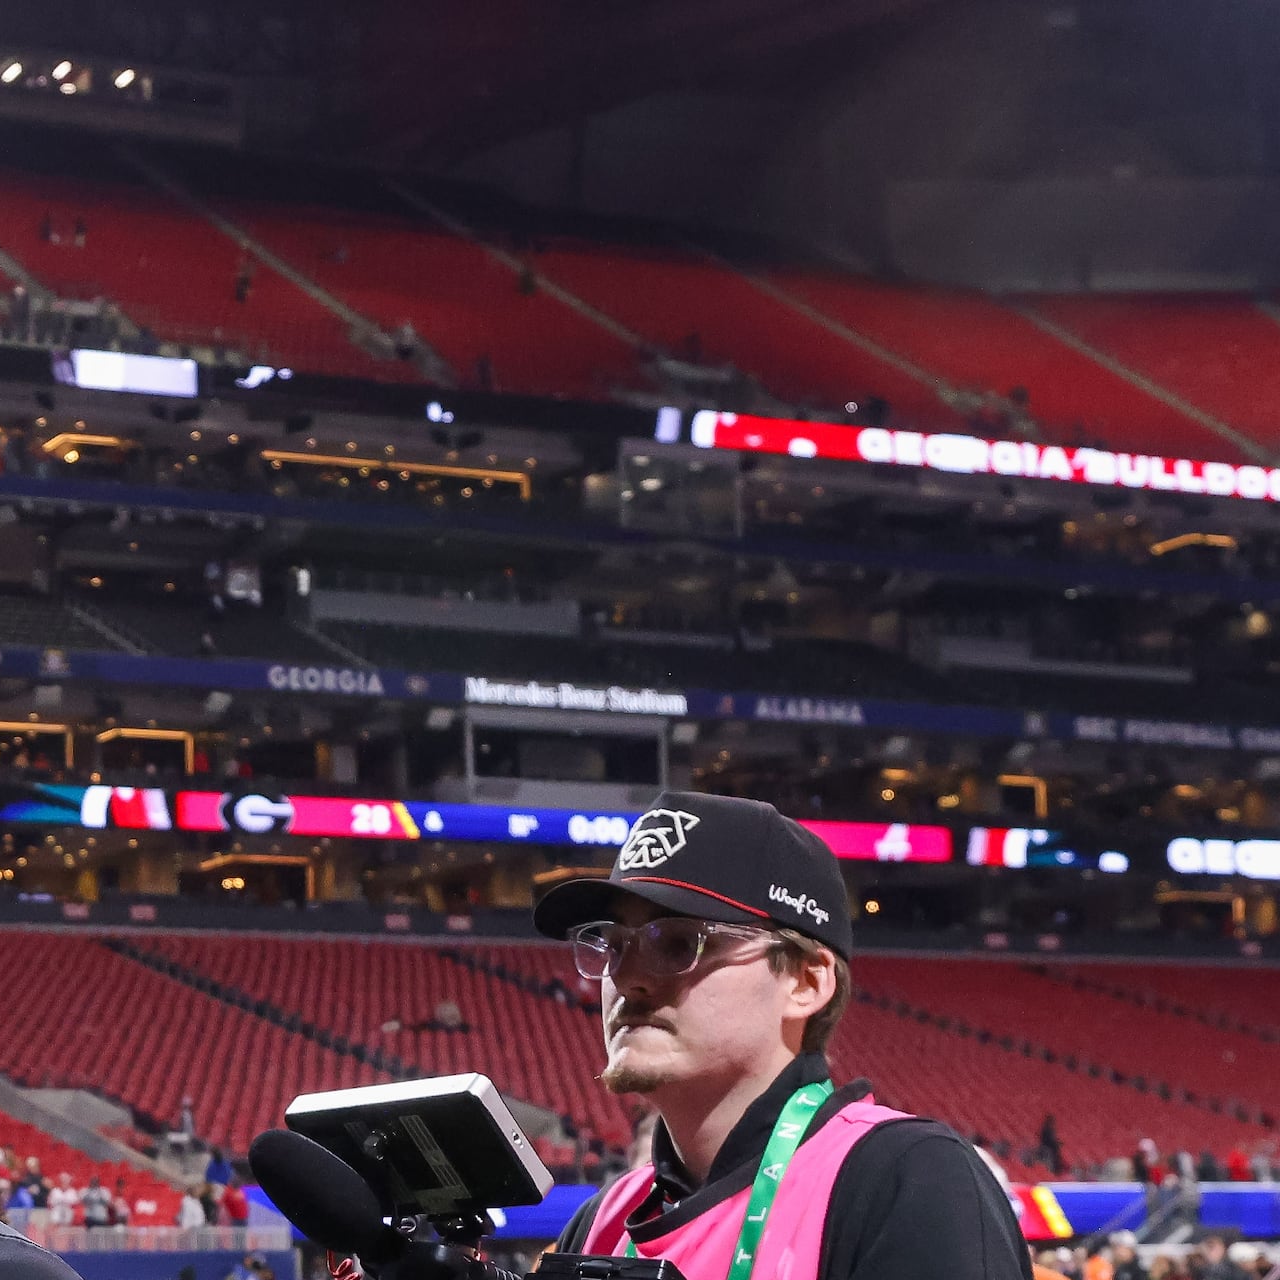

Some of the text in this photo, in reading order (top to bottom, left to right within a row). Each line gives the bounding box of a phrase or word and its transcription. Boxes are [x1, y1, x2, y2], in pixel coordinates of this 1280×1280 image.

[857, 428, 1074, 481] GEORGIA
[267, 664, 384, 695] GEORGIA
[350, 803, 391, 834] 28
[768, 884, 807, 915] Woof
